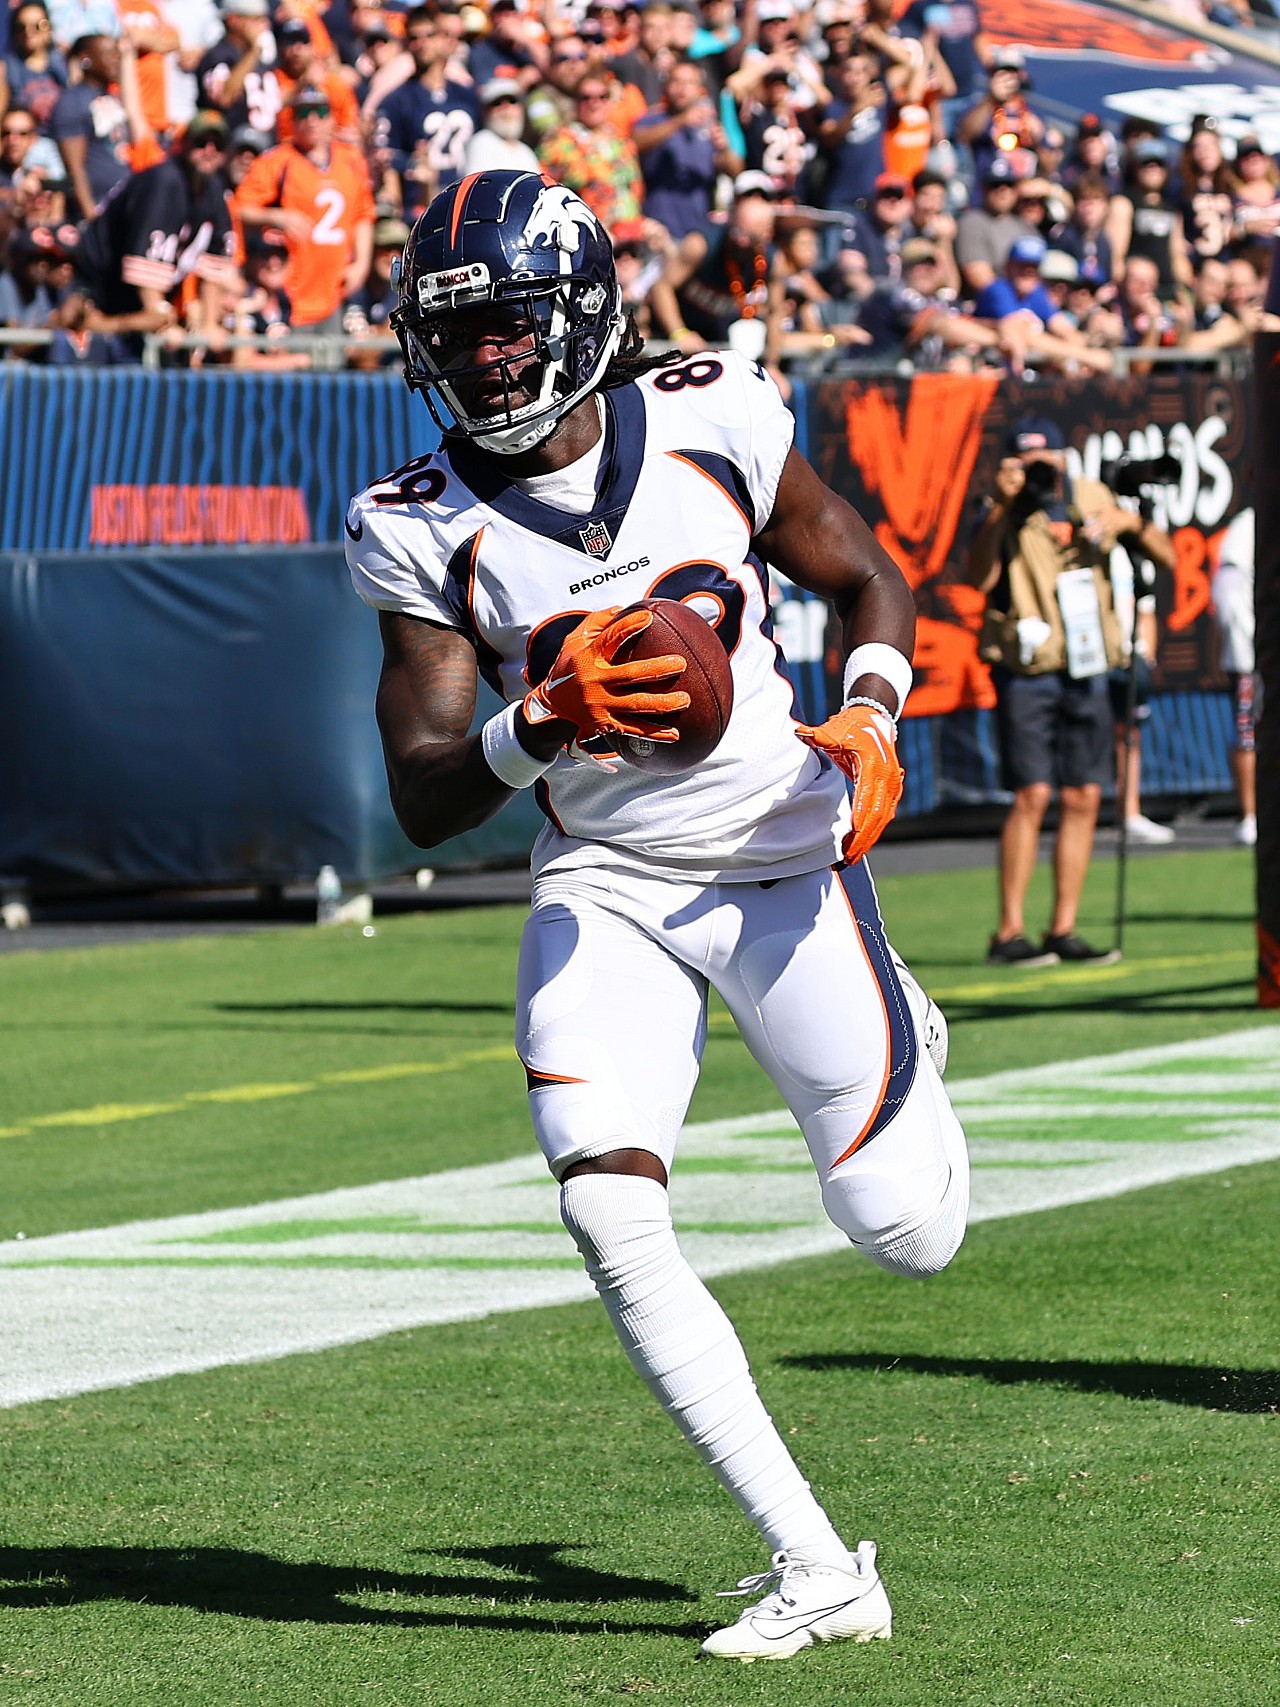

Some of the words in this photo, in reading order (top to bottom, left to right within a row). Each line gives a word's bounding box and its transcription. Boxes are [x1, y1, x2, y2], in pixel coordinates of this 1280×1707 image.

[311, 189, 346, 245] 2
[652, 350, 724, 393] 8
[568, 555, 651, 595] BRONCOS
